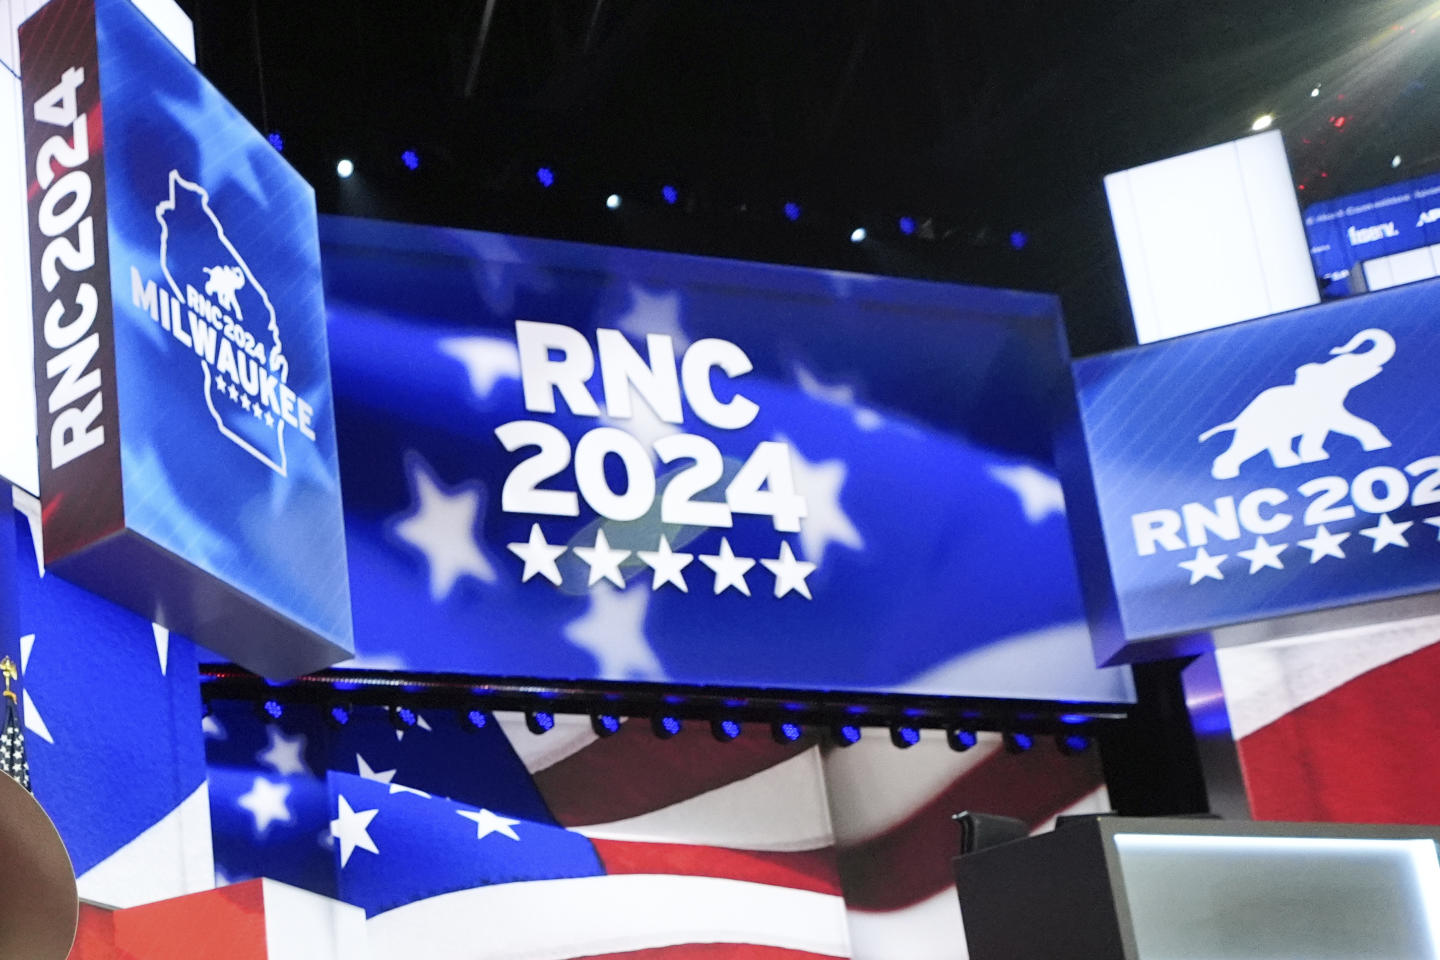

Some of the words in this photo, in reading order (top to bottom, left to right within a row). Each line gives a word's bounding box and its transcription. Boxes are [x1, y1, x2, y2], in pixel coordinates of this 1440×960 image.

[33, 65, 96, 293] 2024
[43, 282, 105, 470] RNC
[130, 264, 316, 442] MILWAUKEE
[186, 283, 224, 331] RNC
[222, 314, 267, 366] 2024
[515, 318, 760, 431] RNC
[494, 419, 808, 534] 2024
[1131, 486, 1293, 557] RNC
